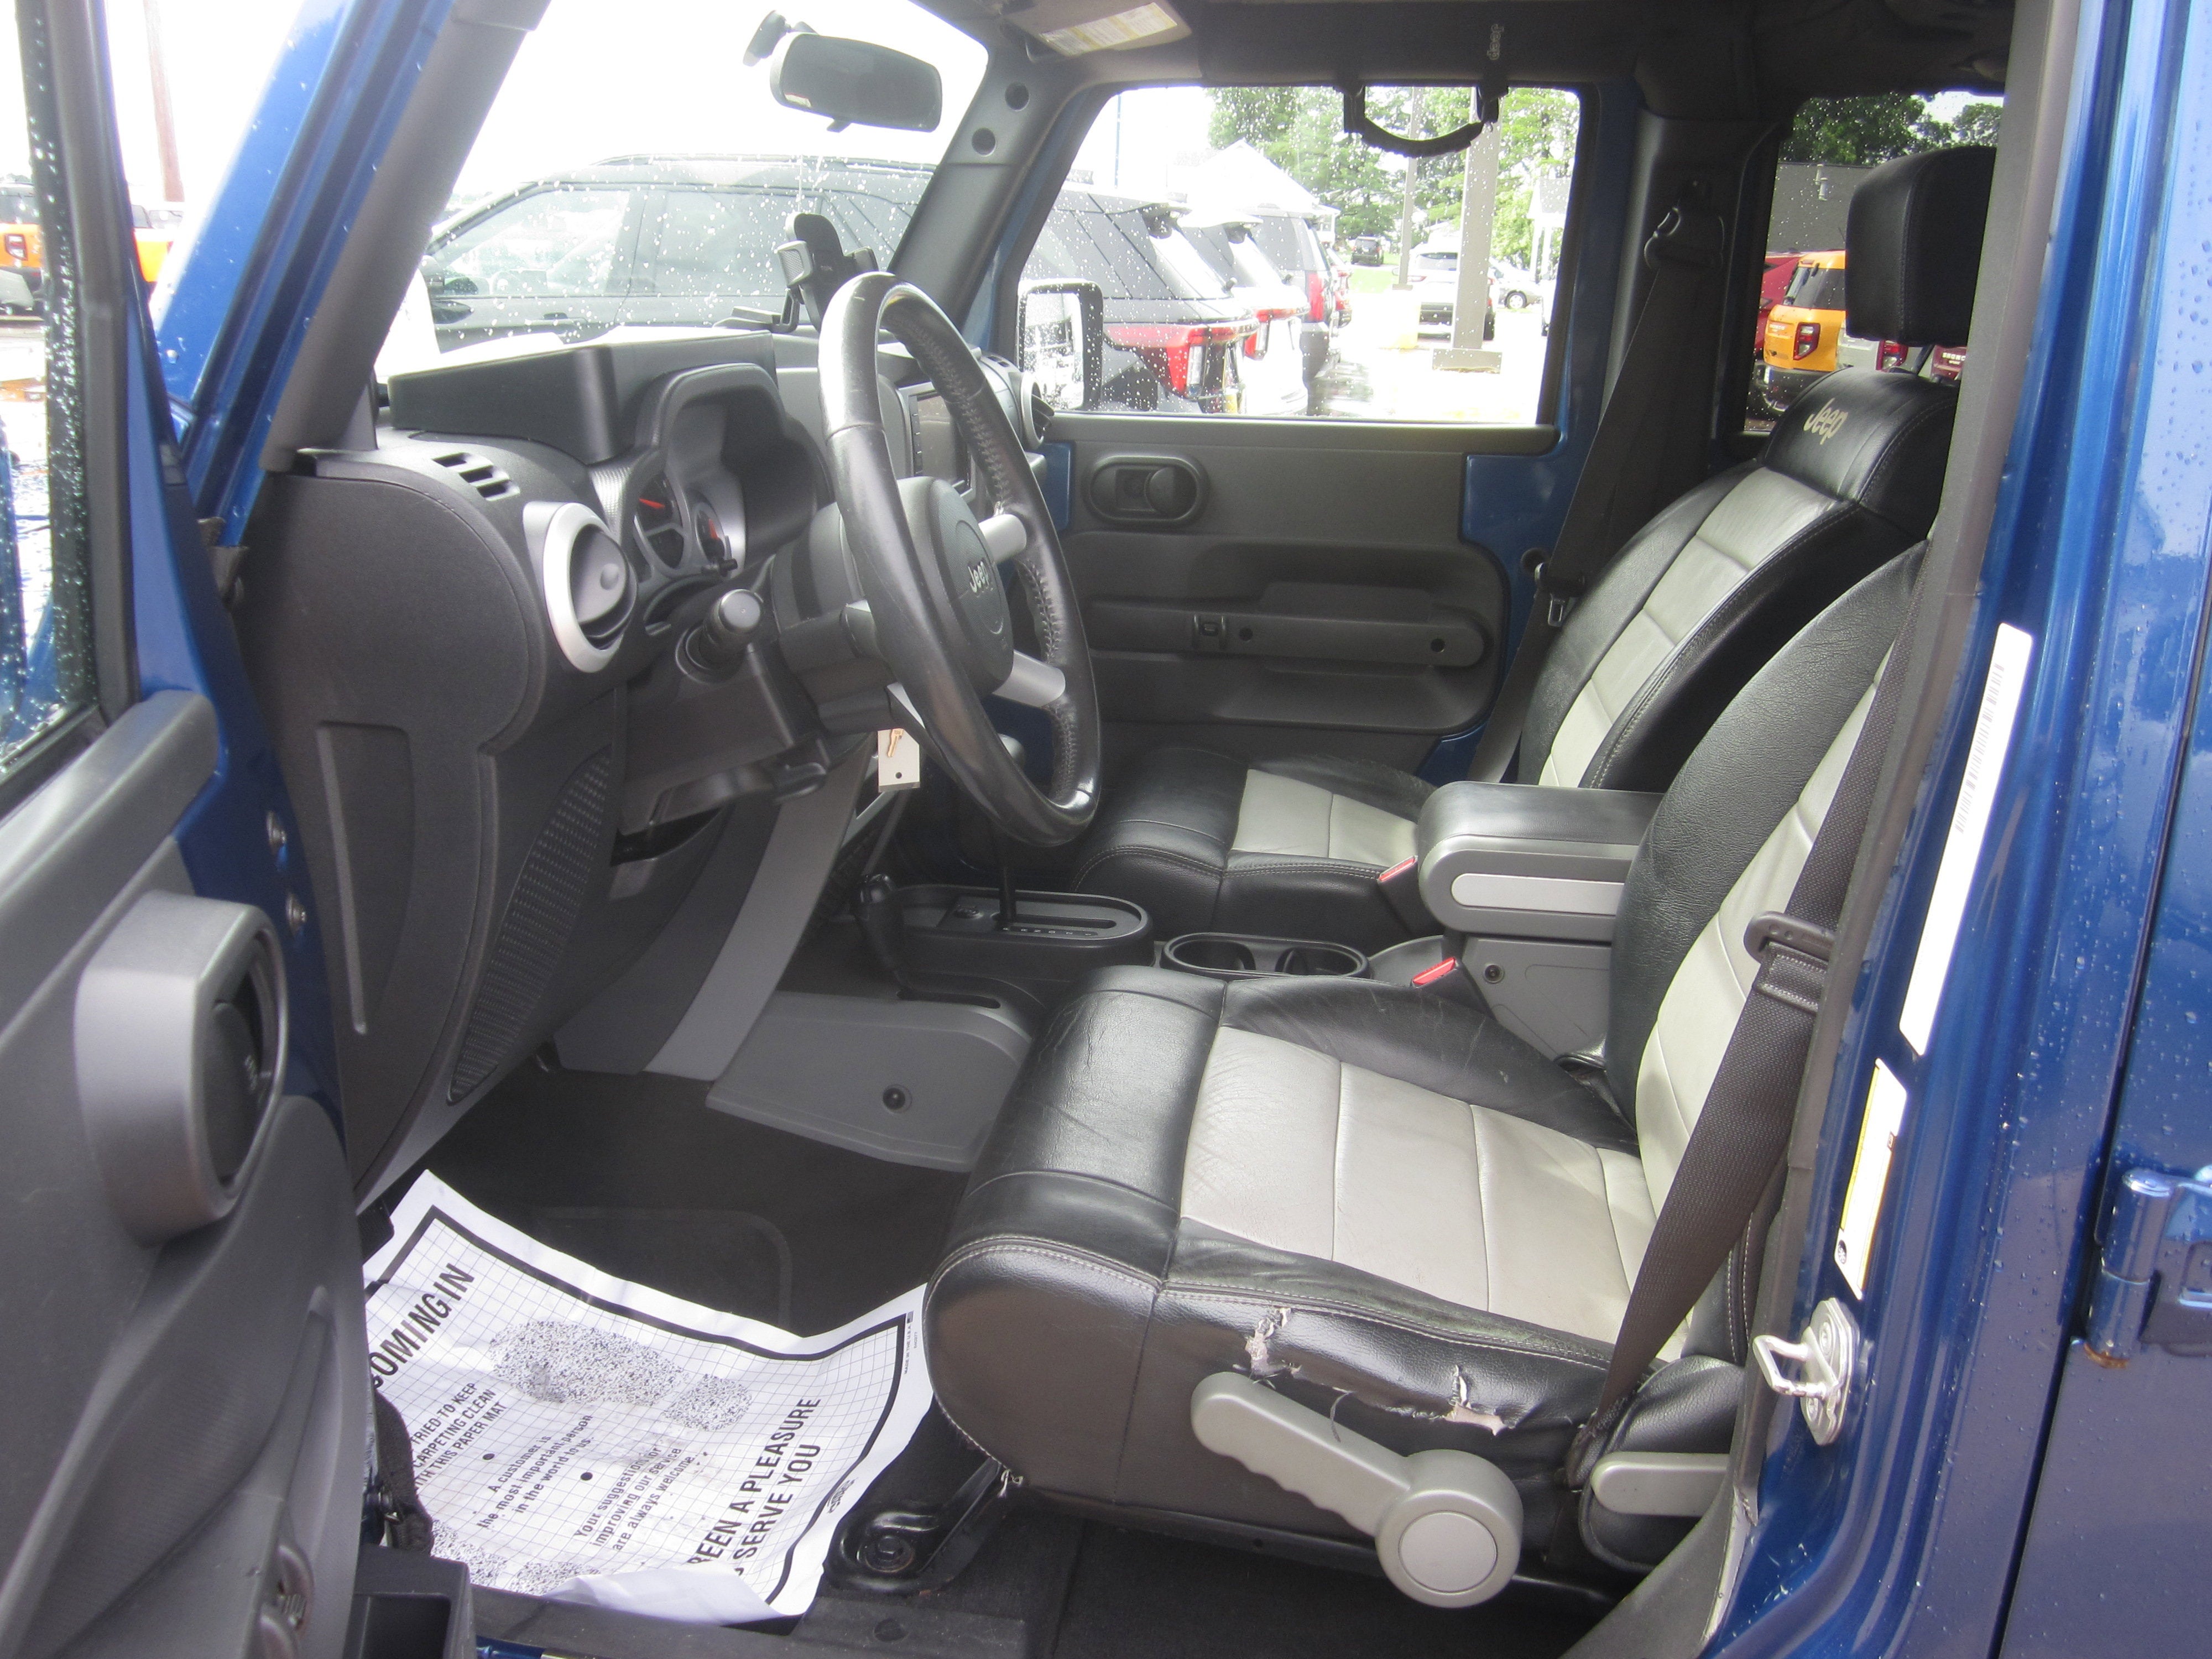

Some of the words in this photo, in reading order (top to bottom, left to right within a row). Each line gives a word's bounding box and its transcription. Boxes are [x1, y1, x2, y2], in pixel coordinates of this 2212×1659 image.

[1942, 352, 1966, 361] BRONC
[1803, 398, 1849, 445] Jeep
[968, 560, 990, 593] Jeep
[433, 1262, 475, 1301] IN
[411, 1418, 441, 1444] TRIED
[437, 1404, 456, 1417] TO
[451, 1383, 477, 1405] KEEP
[413, 1418, 467, 1468] CARPETING
[462, 1389, 496, 1419] CLEAN
[415, 1470, 435, 1489] ITH
[429, 1450, 458, 1469] THIS
[453, 1421, 488, 1449] PAPER
[482, 1401, 507, 1422] MAT
[477, 1513, 498, 1528] the
[495, 1484, 522, 1510] most
[516, 1442, 565, 1482] important
[562, 1415, 593, 1443] person
[498, 1444, 541, 1483] customer
[739, 1399, 822, 1493] PLEASURE
[512, 1503, 529, 1513] in
[523, 1484, 544, 1501] the
[540, 1456, 569, 1481] world
[564, 1447, 579, 1455] to
[589, 1494, 640, 1547] improving
[634, 1475, 653, 1491] our
[649, 1448, 682, 1474] service
[613, 1532, 632, 1551] are
[628, 1493, 660, 1529] always
[656, 1454, 698, 1491] welcome.
[729, 1500, 755, 1514] A
[733, 1493, 794, 1559] SERVE
[776, 1444, 821, 1485] YOU
[573, 1513, 601, 1537] Your
